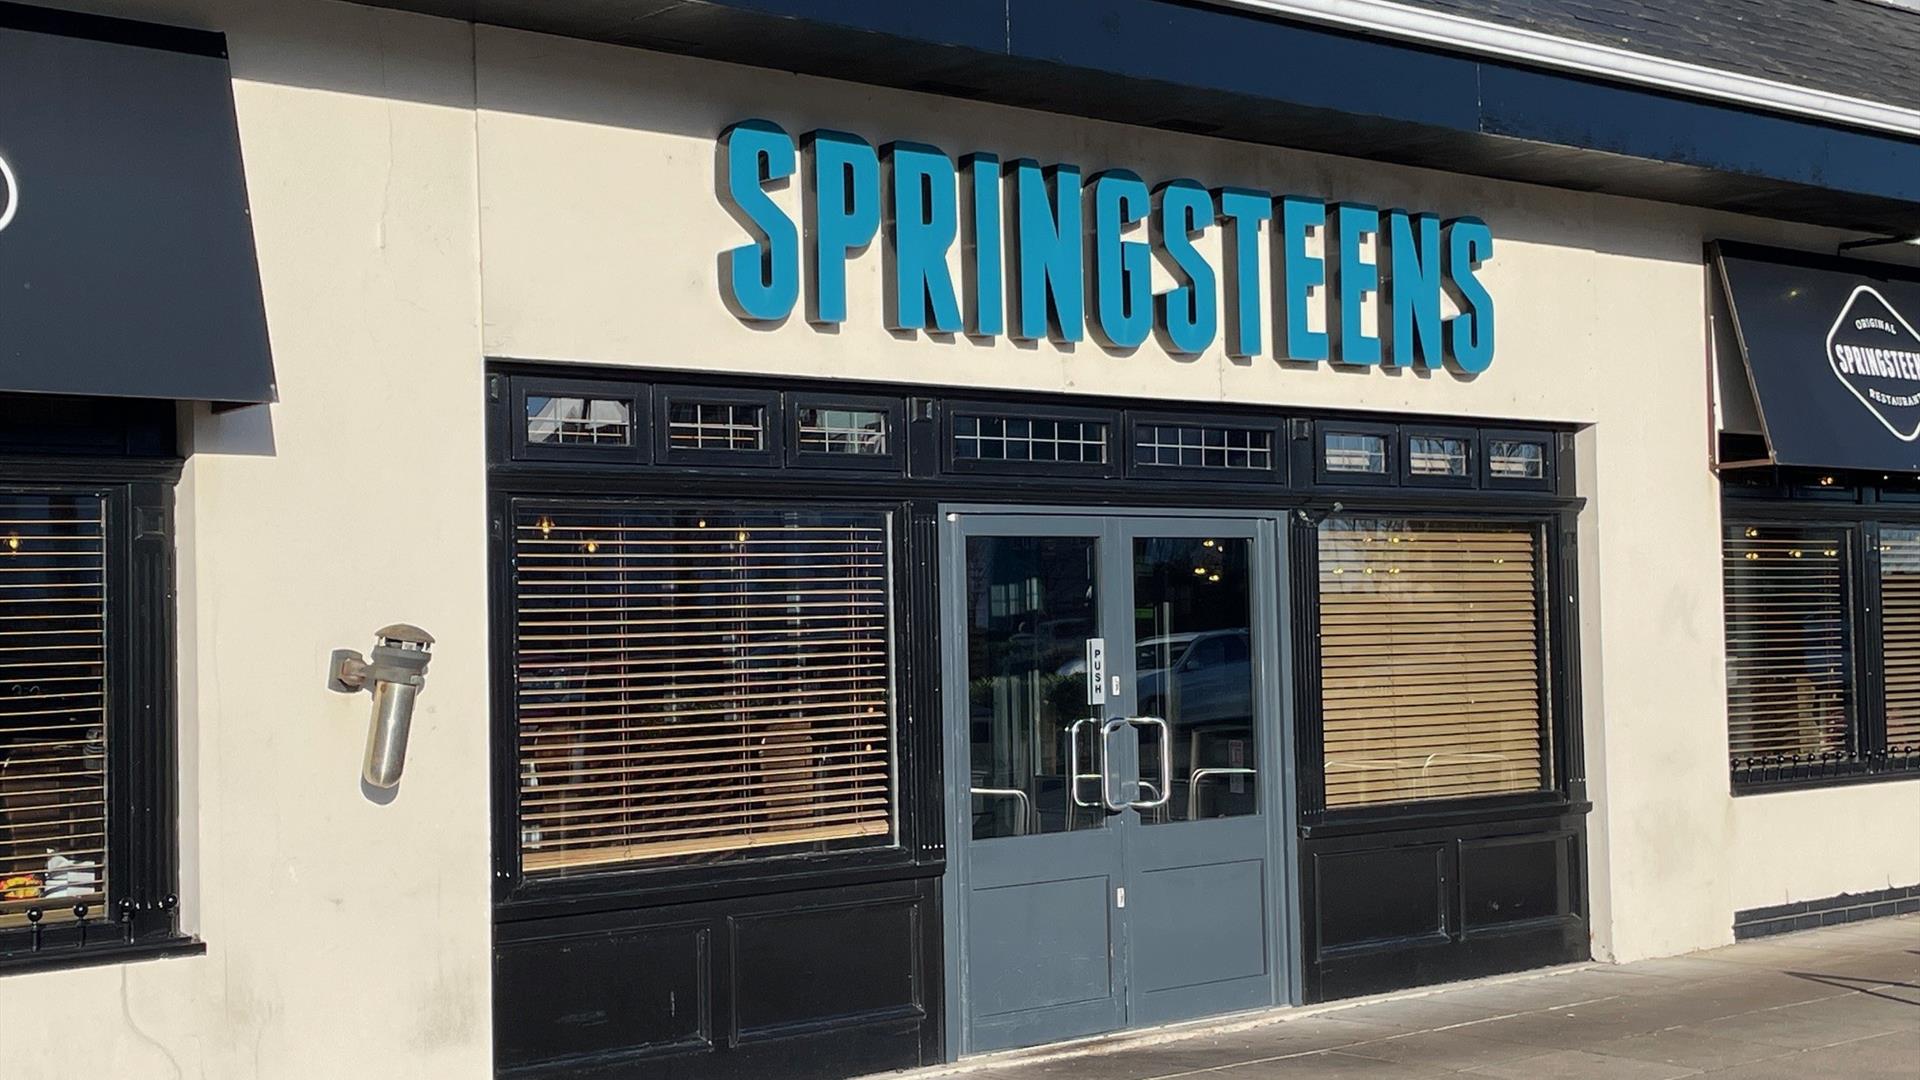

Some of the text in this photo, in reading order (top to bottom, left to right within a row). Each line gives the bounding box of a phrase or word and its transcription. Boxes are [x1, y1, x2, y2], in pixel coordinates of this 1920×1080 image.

[720, 120, 1495, 379] SPRINGSTEENS
[1855, 318, 1897, 334] ORIGINAL
[1094, 649, 1102, 694] PUSH
